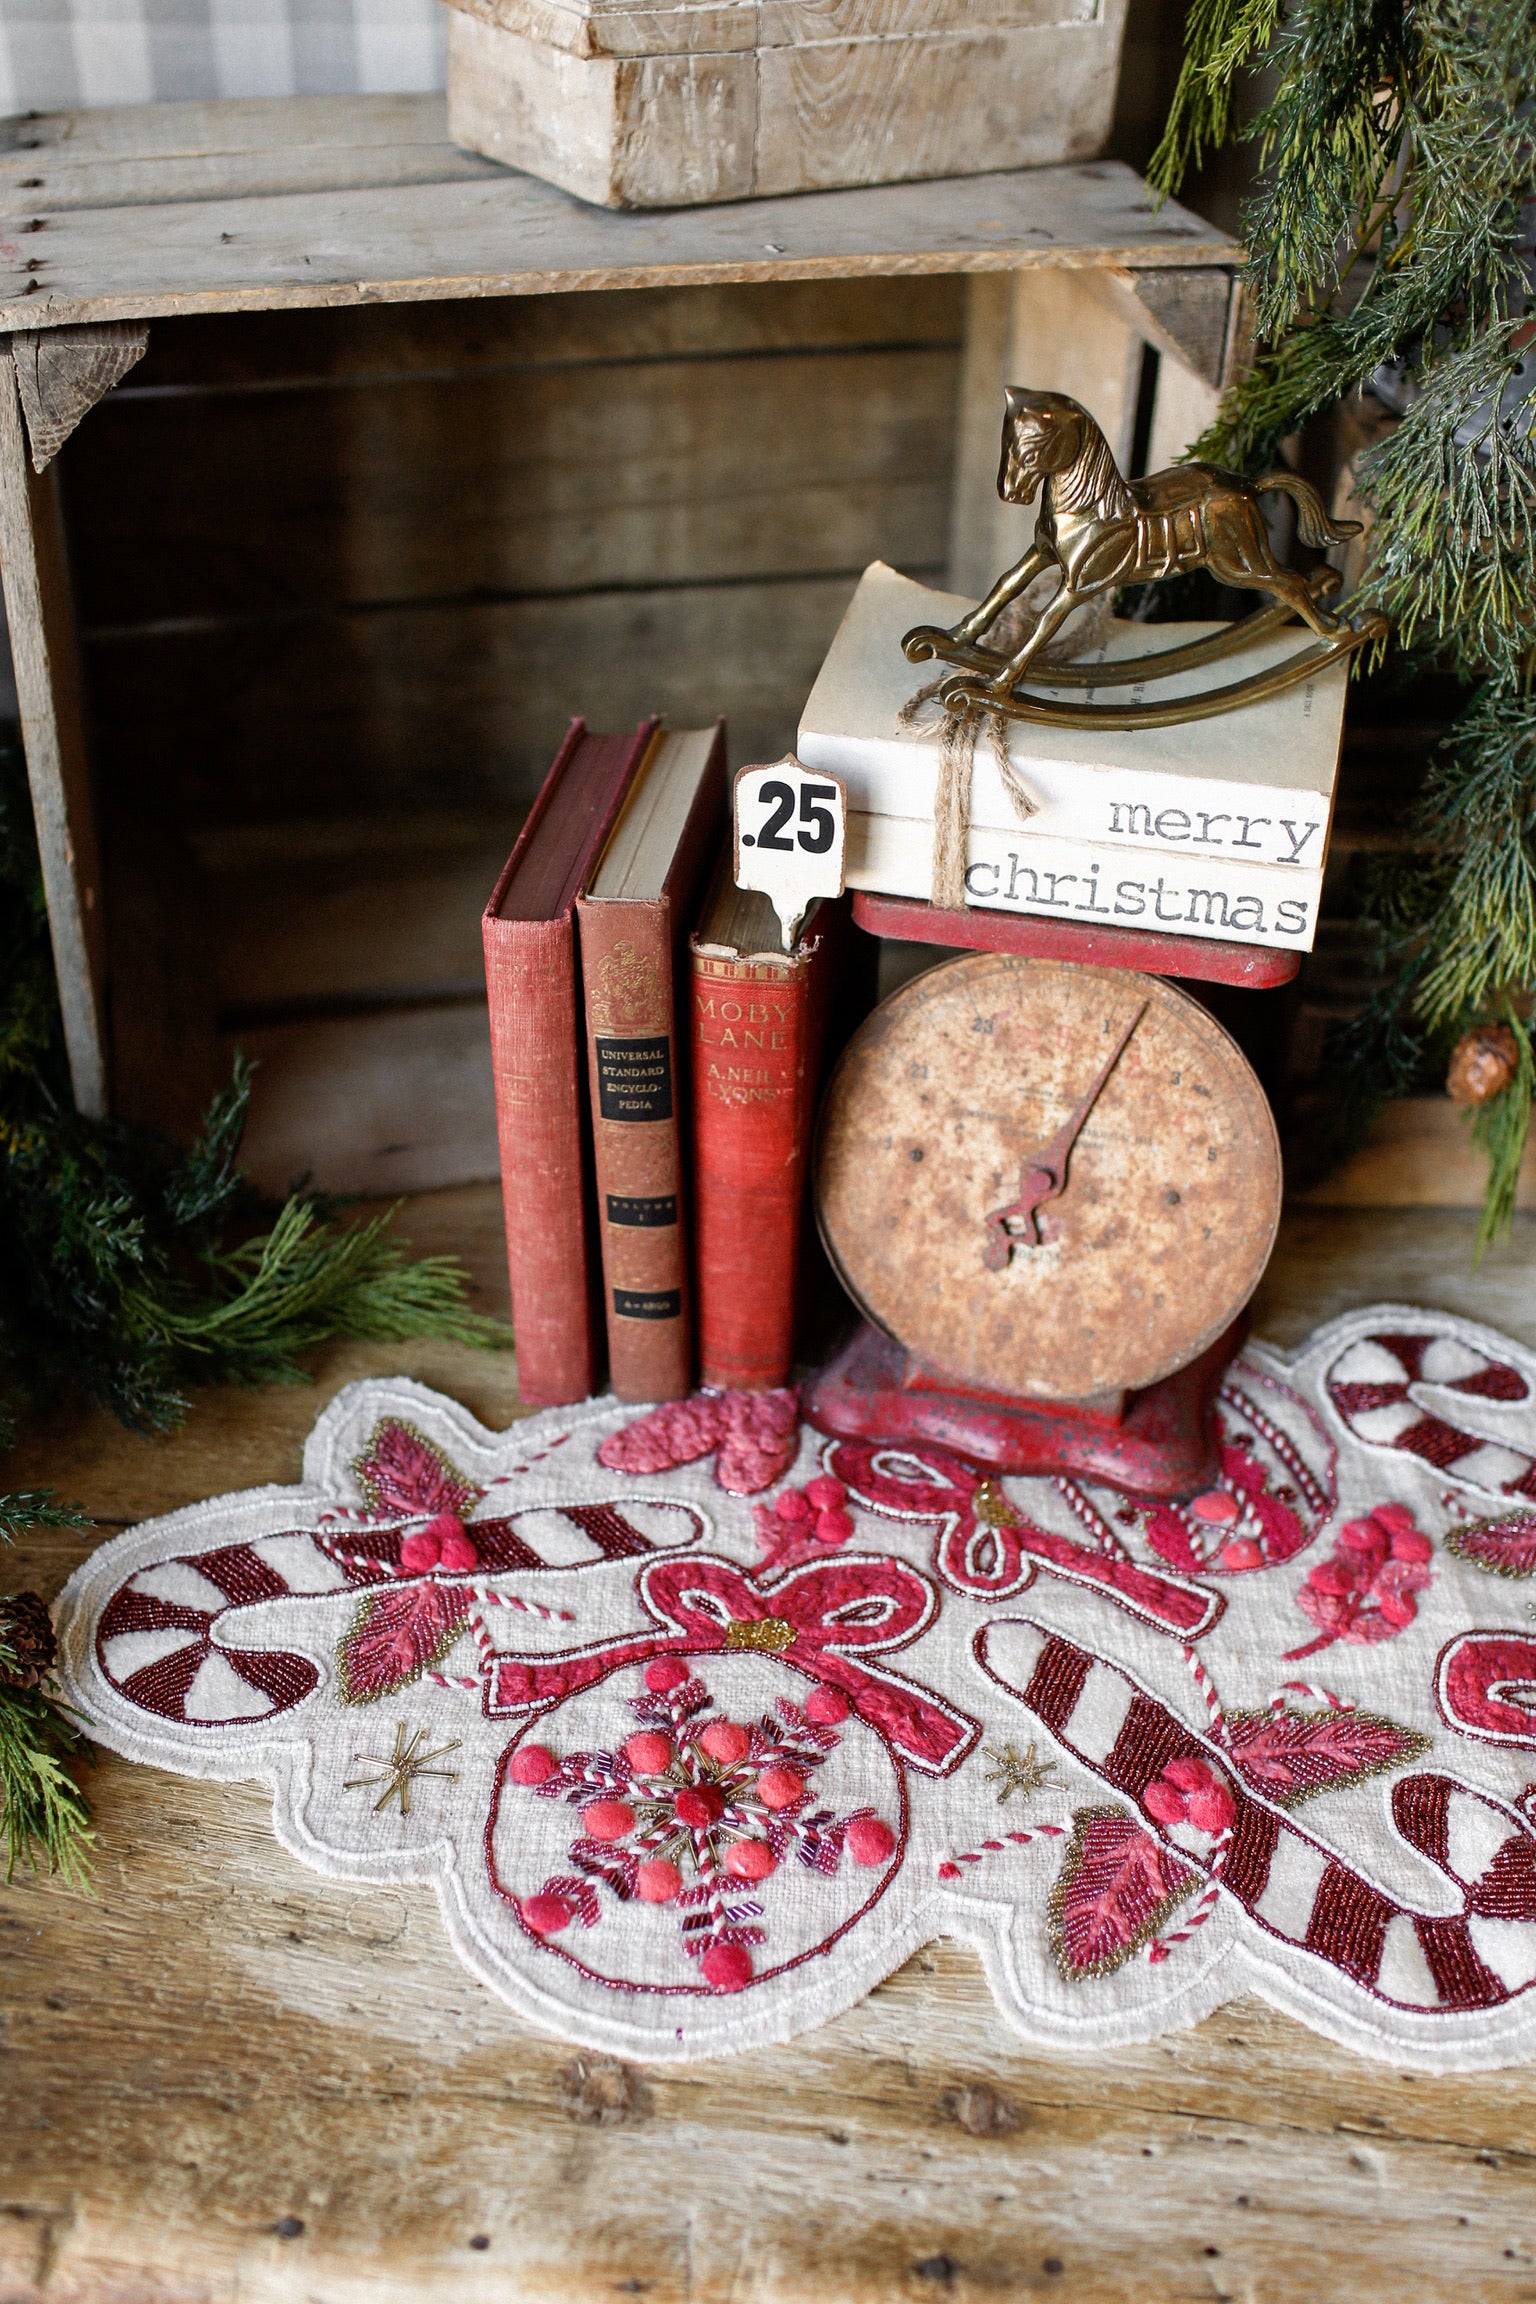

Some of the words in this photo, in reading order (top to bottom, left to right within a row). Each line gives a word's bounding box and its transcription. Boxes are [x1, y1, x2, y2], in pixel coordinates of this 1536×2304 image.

[741, 780, 837, 854] .25
[1108, 802, 1320, 863] merry
[964, 853, 1308, 935] christmas
[696, 995, 794, 1024] MOBY
[972, 1017, 994, 1034] 23
[700, 1022, 788, 1050] LANE
[601, 1050, 664, 1061] UNIVERSAL
[602, 1065, 665, 1077] STANDARD
[1170, 1071, 1181, 1086] 3
[606, 1082, 661, 1093] ENCYCLO-
[707, 1080, 777, 1101] LYONS
[618, 1100, 652, 1110] PEDIA
[1207, 1146, 1217, 1161] 5
